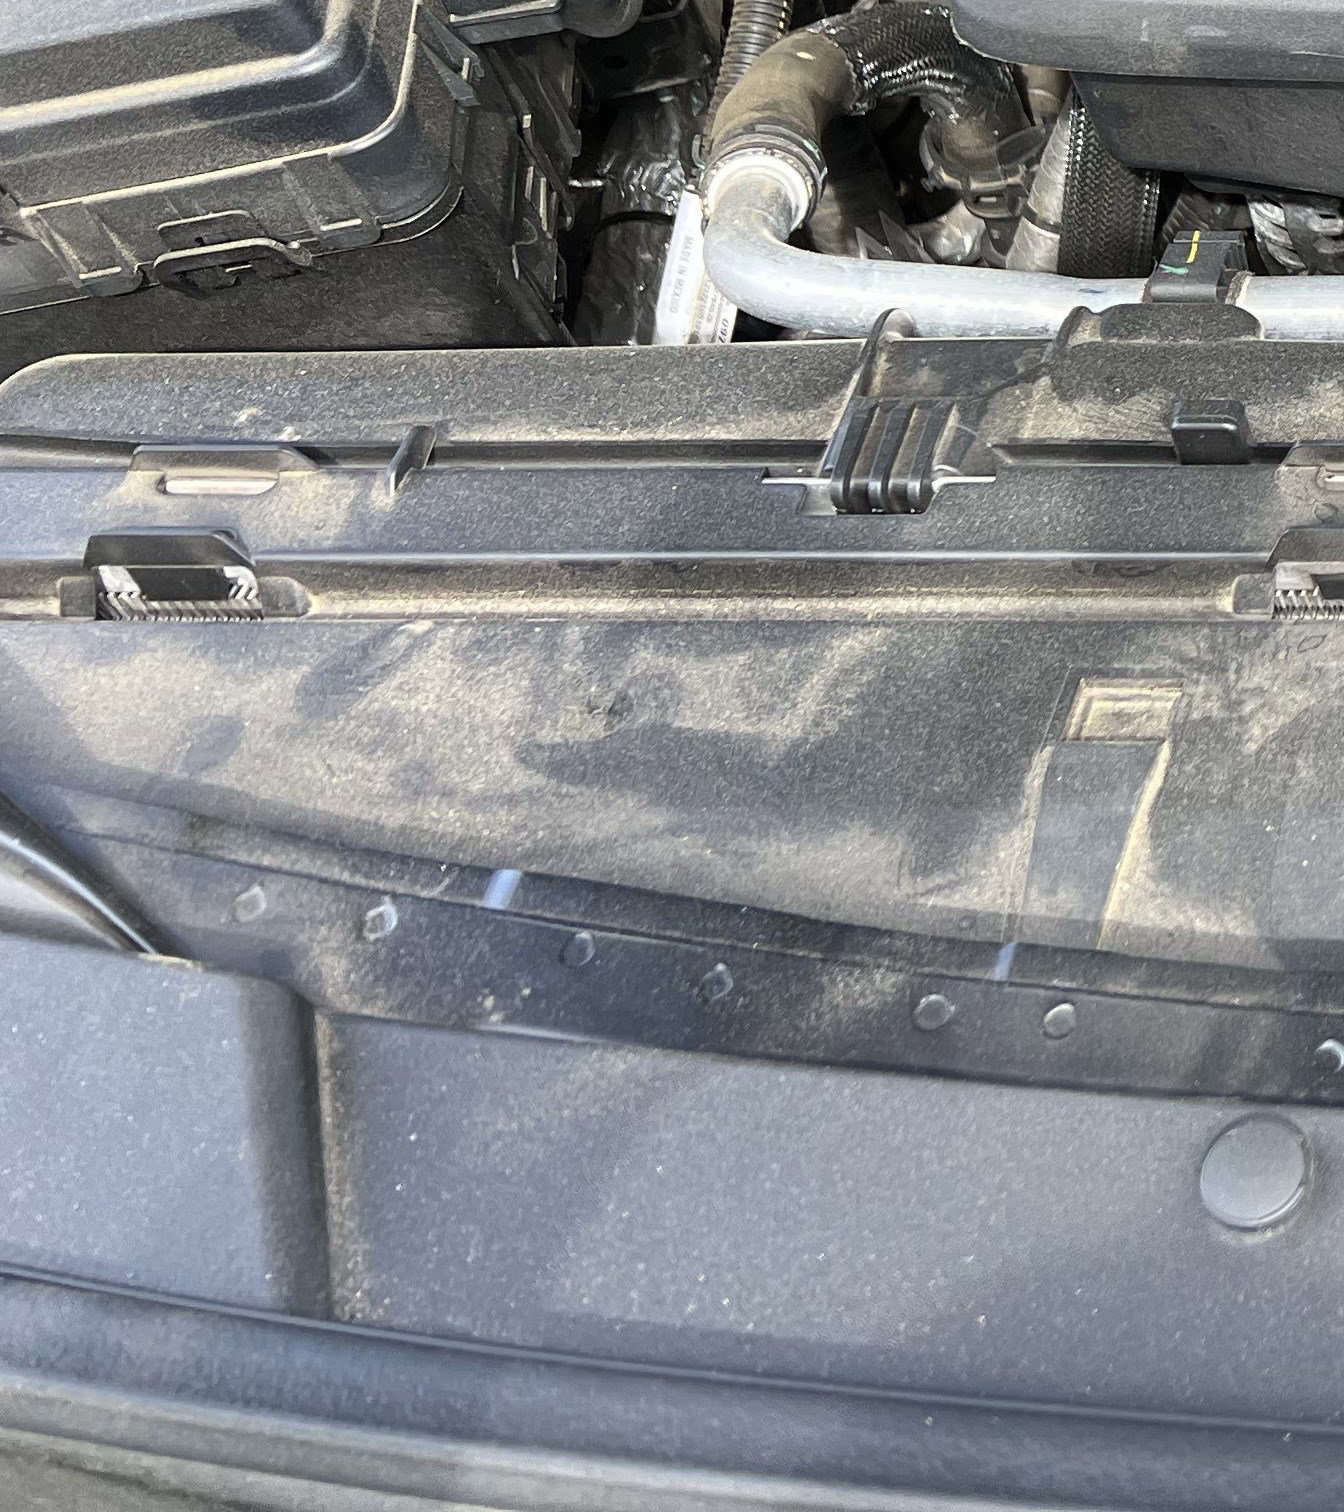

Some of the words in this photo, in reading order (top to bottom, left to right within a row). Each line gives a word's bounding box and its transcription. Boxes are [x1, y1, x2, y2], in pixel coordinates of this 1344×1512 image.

[680, 235, 694, 263] MADE
[678, 265, 687, 276] IN
[670, 278, 684, 314] MEXICO
